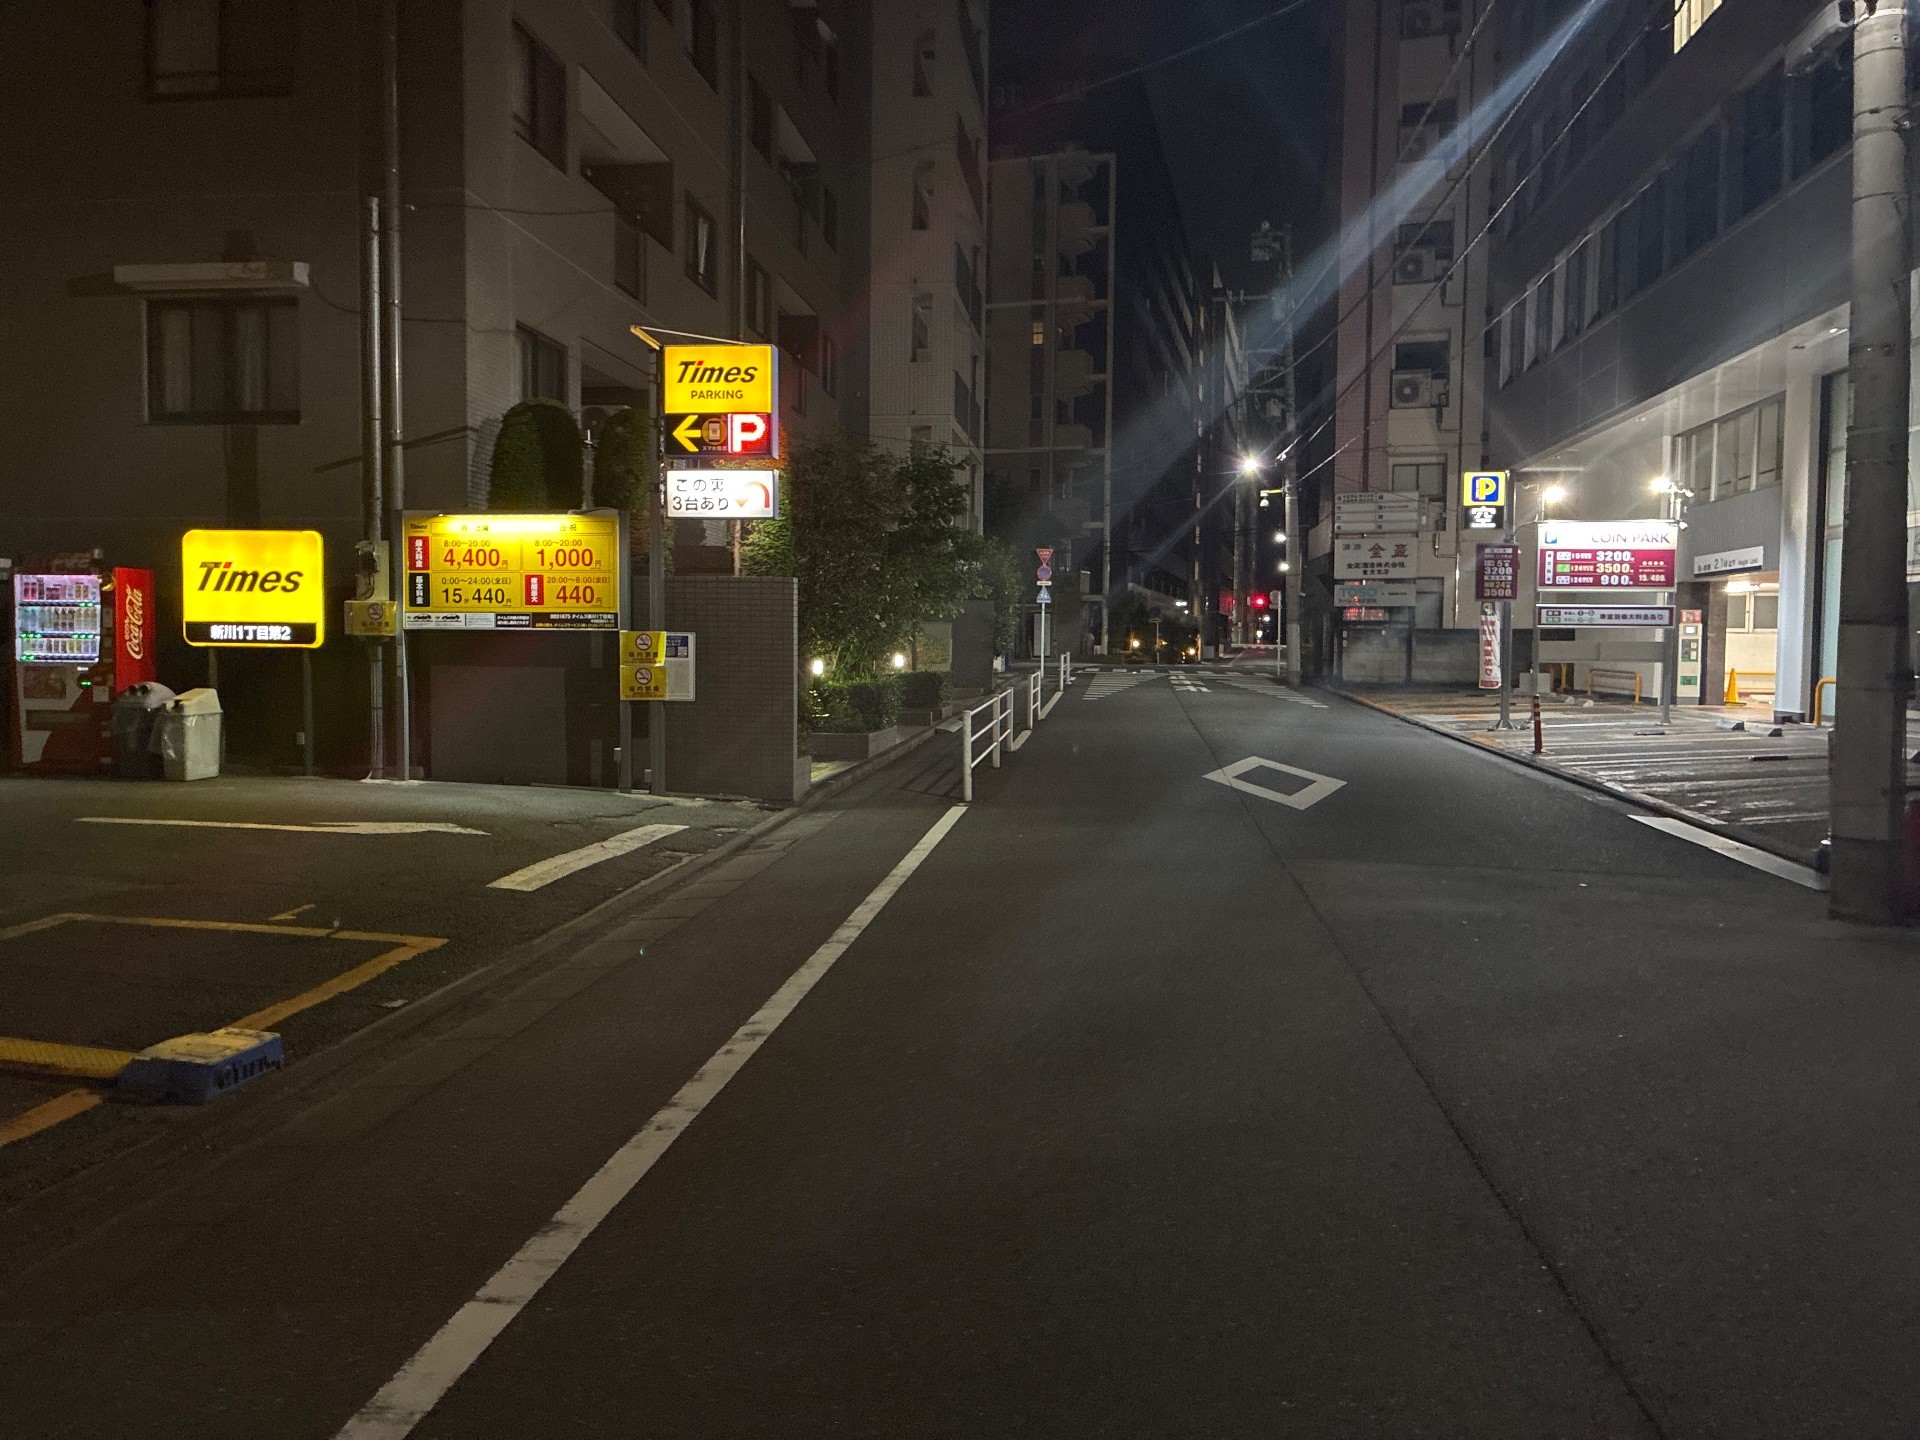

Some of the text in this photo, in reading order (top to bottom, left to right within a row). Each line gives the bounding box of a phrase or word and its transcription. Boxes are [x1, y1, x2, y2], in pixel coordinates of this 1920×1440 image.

[677, 360, 758, 384] Times
[690, 389, 744, 400] PARKING
[731, 414, 766, 453] P
[672, 496, 729, 511] 3台あり
[1470, 505, 1497, 528] 空
[1632, 532, 1670, 544] PARK
[1595, 562, 1631, 574] 3500
[197, 561, 304, 593] Times
[210, 624, 292, 641] 新川1丁目第2
